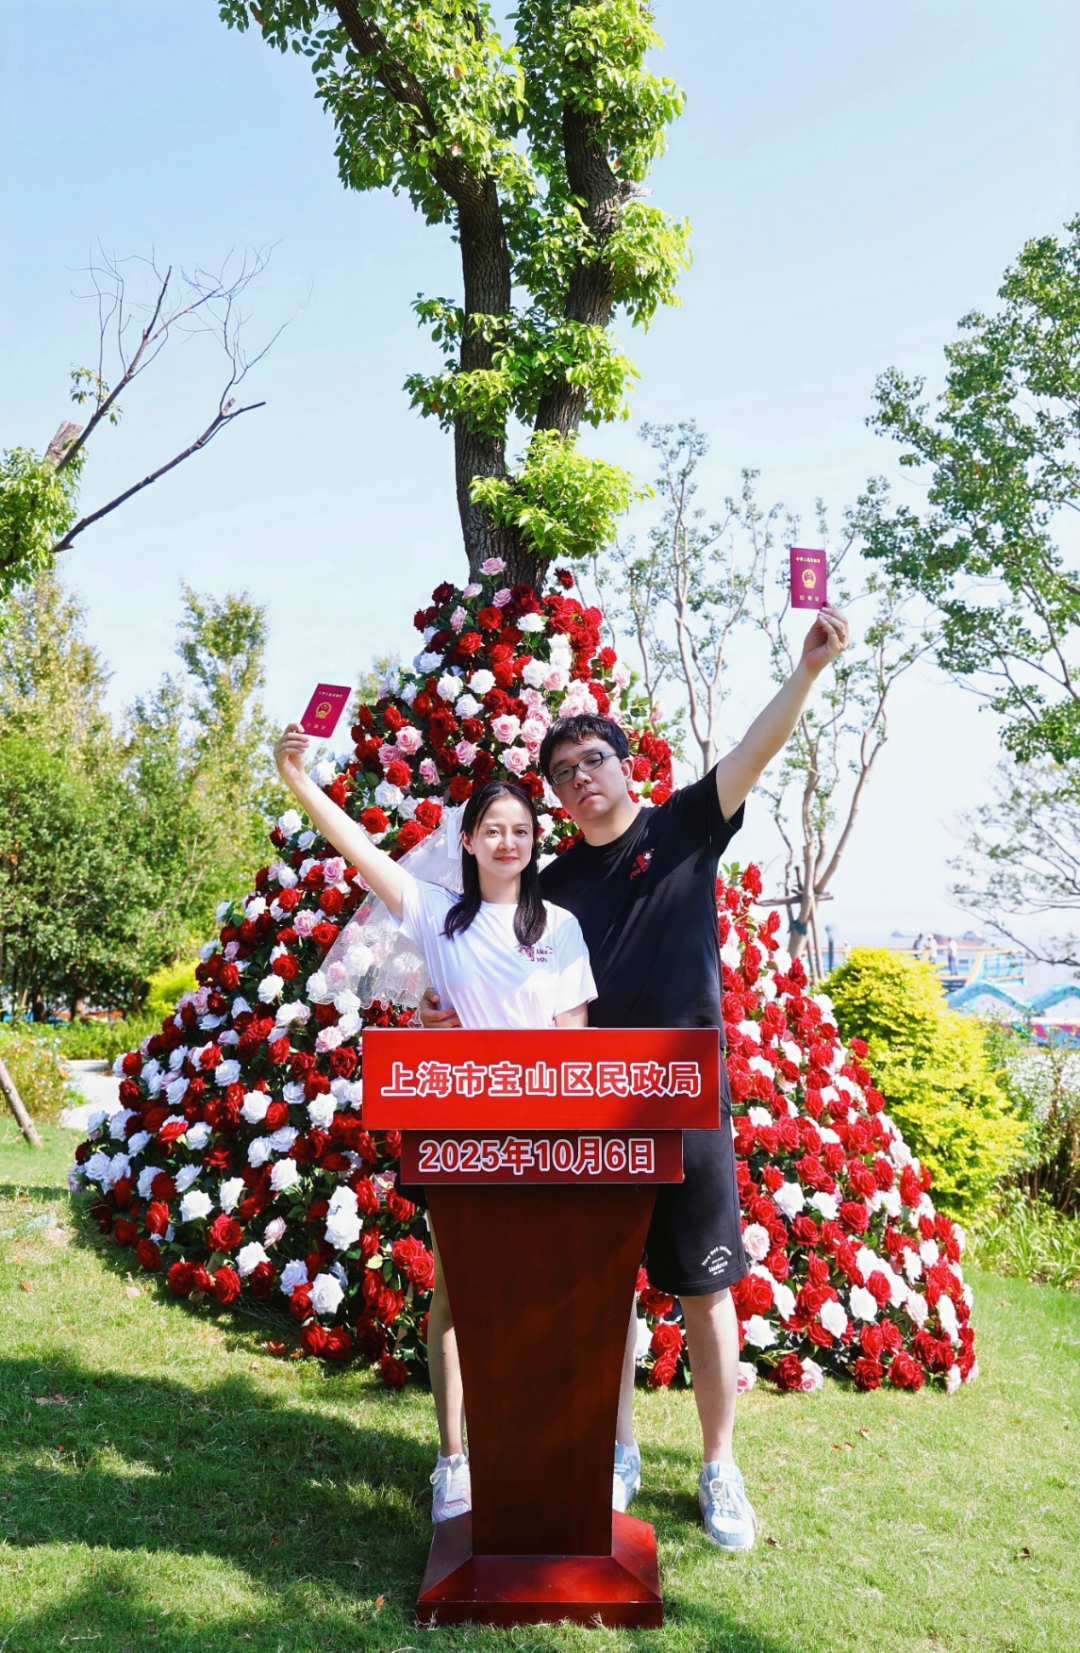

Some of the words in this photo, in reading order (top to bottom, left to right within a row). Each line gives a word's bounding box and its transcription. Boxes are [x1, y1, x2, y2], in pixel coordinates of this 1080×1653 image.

[381, 1061, 701, 1098] 上海市宝山区民政局
[419, 1136, 655, 1175] 2025年10月6日
